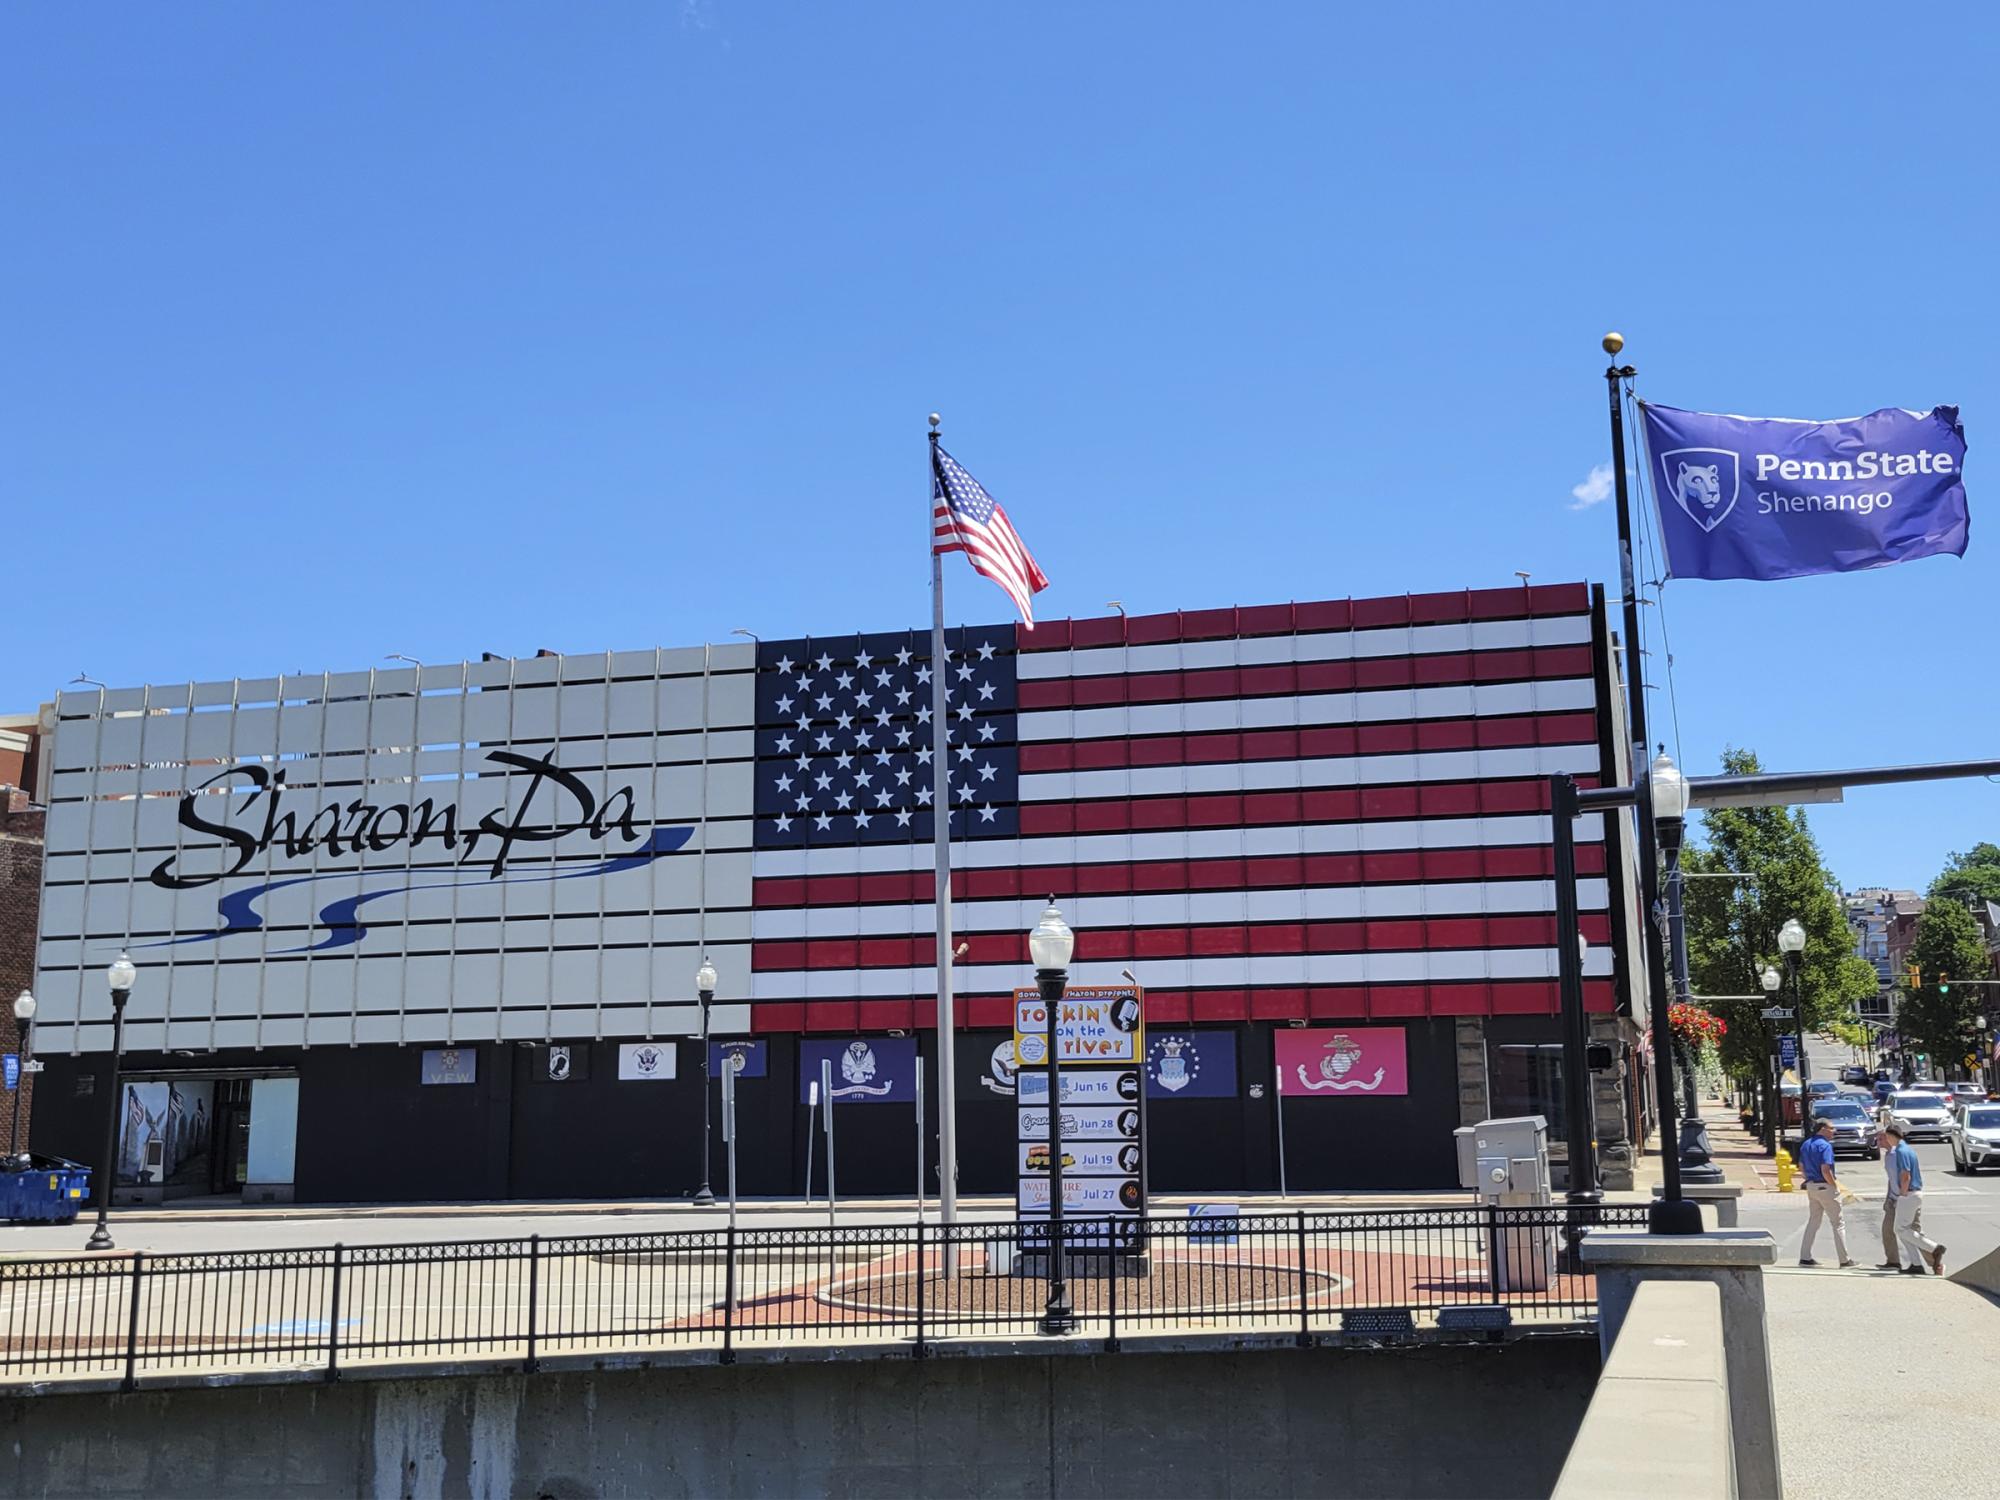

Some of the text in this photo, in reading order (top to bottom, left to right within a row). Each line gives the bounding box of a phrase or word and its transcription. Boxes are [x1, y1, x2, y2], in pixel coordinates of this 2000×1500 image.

[1755, 449, 1954, 481] PennState
[1757, 491, 1893, 514] Shenango
[430, 1072, 470, 1083] VFW
[1073, 1081, 1093, 1091] Jun
[1096, 1082, 1108, 1091] 16
[1080, 1119, 1114, 1128] Jun 28
[1082, 1154, 1113, 1164] Jul 19
[1083, 1189, 1100, 1199] Jul
[1102, 1190, 1115, 1199] 27
